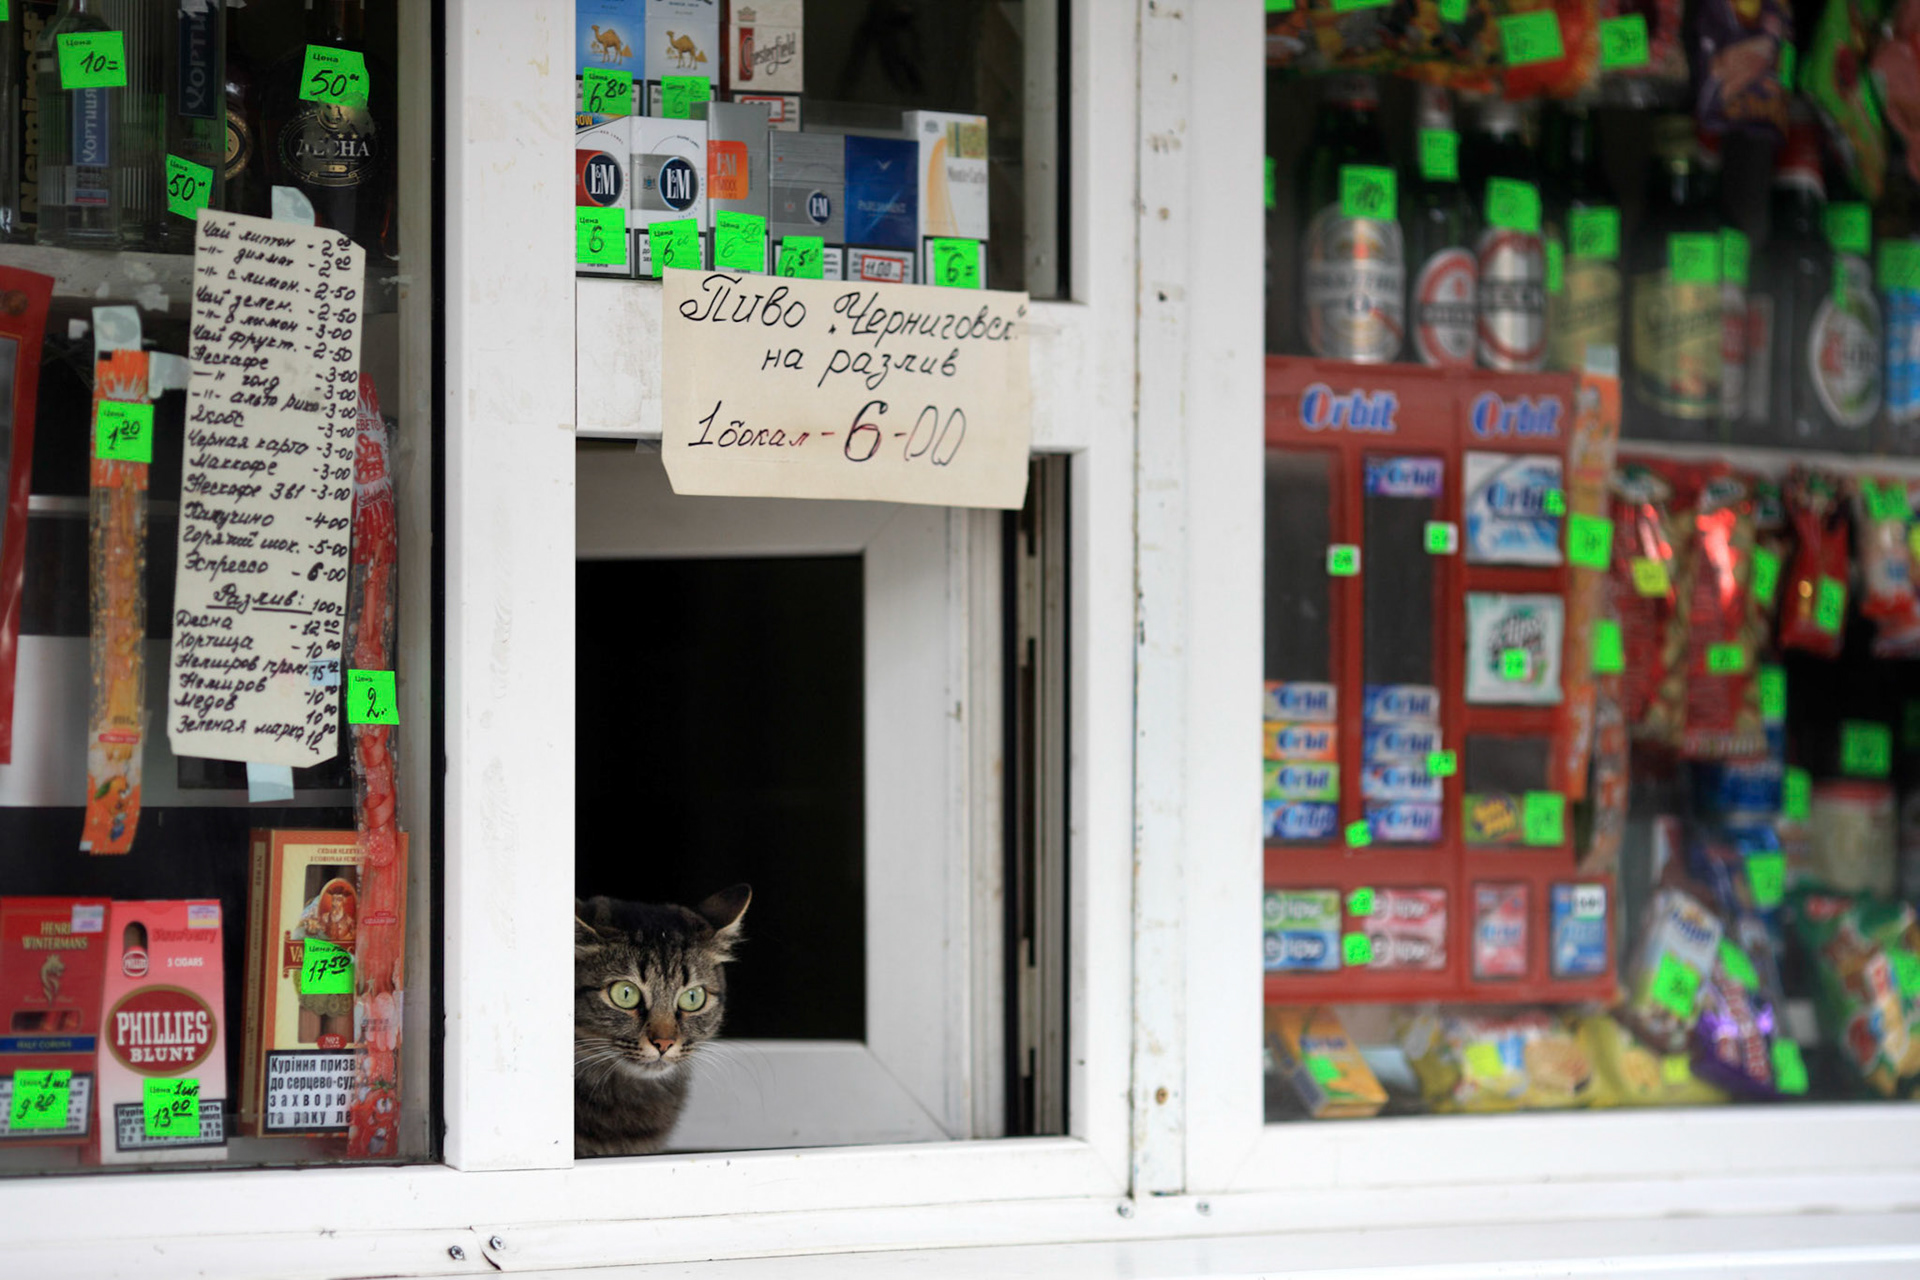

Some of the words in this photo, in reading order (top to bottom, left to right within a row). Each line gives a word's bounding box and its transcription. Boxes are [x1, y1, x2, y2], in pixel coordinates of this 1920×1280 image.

[65, 38, 92, 46] Цена
[313, 54, 339, 63] Цена
[170, 160, 189, 171] Цена
[590, 163, 616, 195] L&M
[666, 168, 691, 200] L&M
[203, 220, 236, 239] Чай
[720, 221, 740, 229] Цена
[196, 285, 231, 306] Чай
[679, 273, 807, 329] Пиво
[192, 325, 226, 342] Чай
[761, 347, 804, 371] на
[817, 347, 961, 391] разлив
[1301, 383, 1397, 433] Orbit
[1472, 392, 1561, 438] Orbit
[719, 420, 810, 448] бокал
[1387, 459, 1438, 486] Orbit
[1278, 687, 1329, 709] Orbit
[1384, 694, 1431, 715] Orbit
[1277, 729, 1329, 750] Orbit
[1384, 731, 1434, 751] Orbit
[1277, 767, 1329, 789] Orbit
[1386, 808, 1432, 828] Orbit
[22, 936, 88, 951] WINTERMANS
[174, 957, 204, 967] CIGARS
[116, 1011, 209, 1047] PHILLIES
[129, 1046, 196, 1063] BLUNT
[271, 1057, 316, 1073] Куріння
[320, 1058, 355, 1073] призв
[270, 1077, 284, 1091] до
[287, 1076, 355, 1091] серцево-суд
[270, 1112, 284, 1125] та
[294, 1111, 326, 1126] раку
